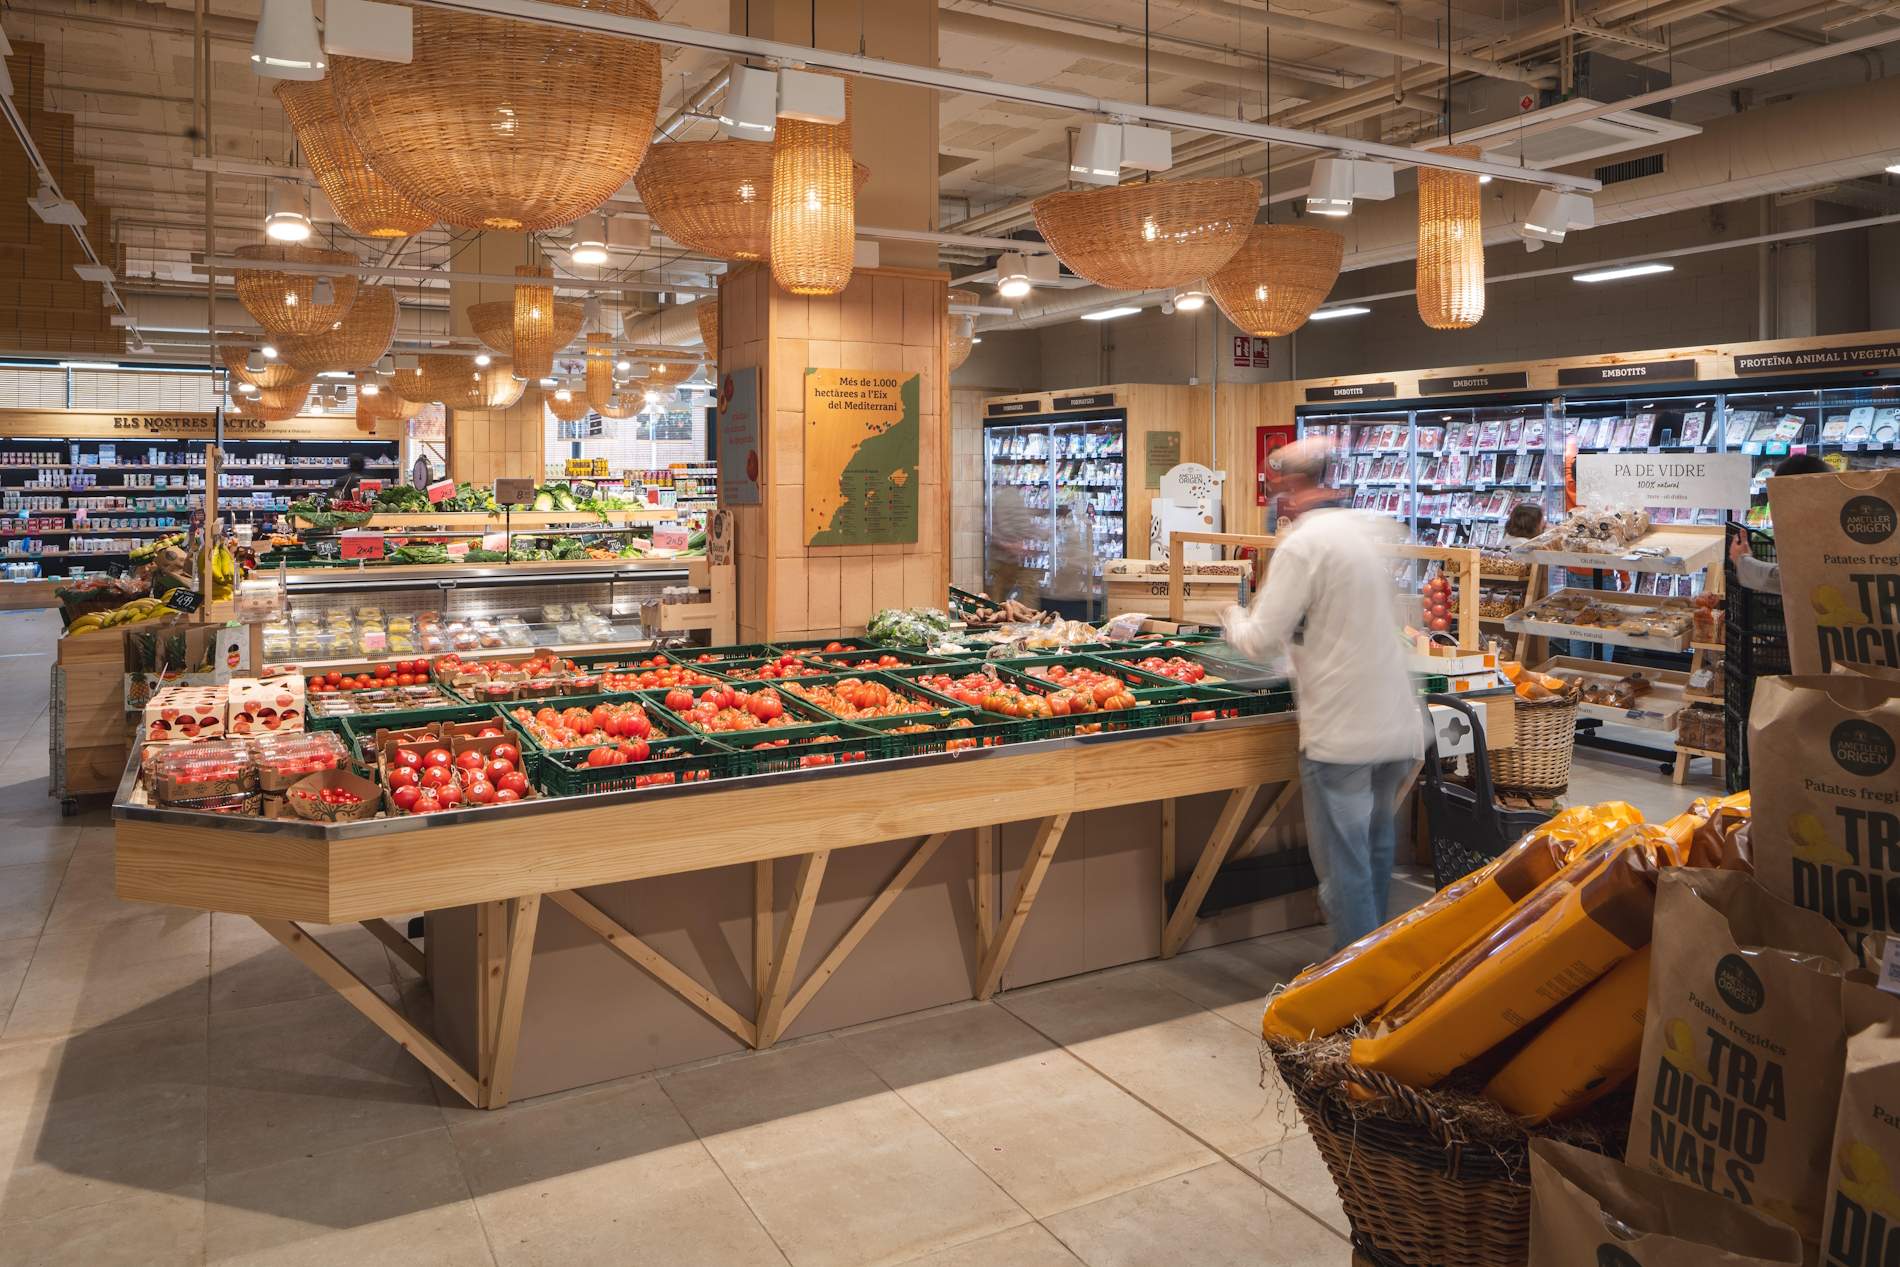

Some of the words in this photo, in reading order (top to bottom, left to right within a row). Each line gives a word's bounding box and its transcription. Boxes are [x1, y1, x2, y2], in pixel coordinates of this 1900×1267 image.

[1740, 356, 1792, 368] PROTEÏNA
[1796, 353, 1840, 364] ANIMAL
[1843, 352, 1848, 361] I
[1602, 367, 1646, 378] EMBOTITS
[840, 377, 857, 386] Més
[860, 378, 870, 386] de
[873, 379, 897, 387] 1.000
[1453, 378, 1488, 388] EMBOTITS
[868, 390, 888, 399] l'Eix
[1333, 387, 1363, 396] EMBOTITS
[828, 401, 841, 410] del
[844, 401, 897, 411] Mediterrani
[113, 417, 138, 429] ELS
[144, 417, 208, 428] NOSTRES
[213, 417, 266, 429] CTICS
[1615, 464, 1631, 477] PA
[1636, 464, 1653, 477] DE
[1657, 464, 1705, 477] VIDRE
[1637, 481, 1655, 489] 100%
[1847, 515, 1890, 523] AMETLLER
[1847, 523, 1891, 533] ORIGEN
[1824, 554, 1866, 565] Patates
[1152, 587, 1191, 596] ORIN
[1817, 625, 1900, 673] DICI
[1837, 749, 1888, 764] ORIGEN
[1805, 779, 1856, 797] Patates
[1688, 992, 1727, 1025] Patates
[1729, 1020, 1787, 1056] fregides
[1706, 1027, 1787, 1121] TRA
[1653, 1056, 1767, 1164] DICIO
[1651, 1110, 1755, 1205] NALS
